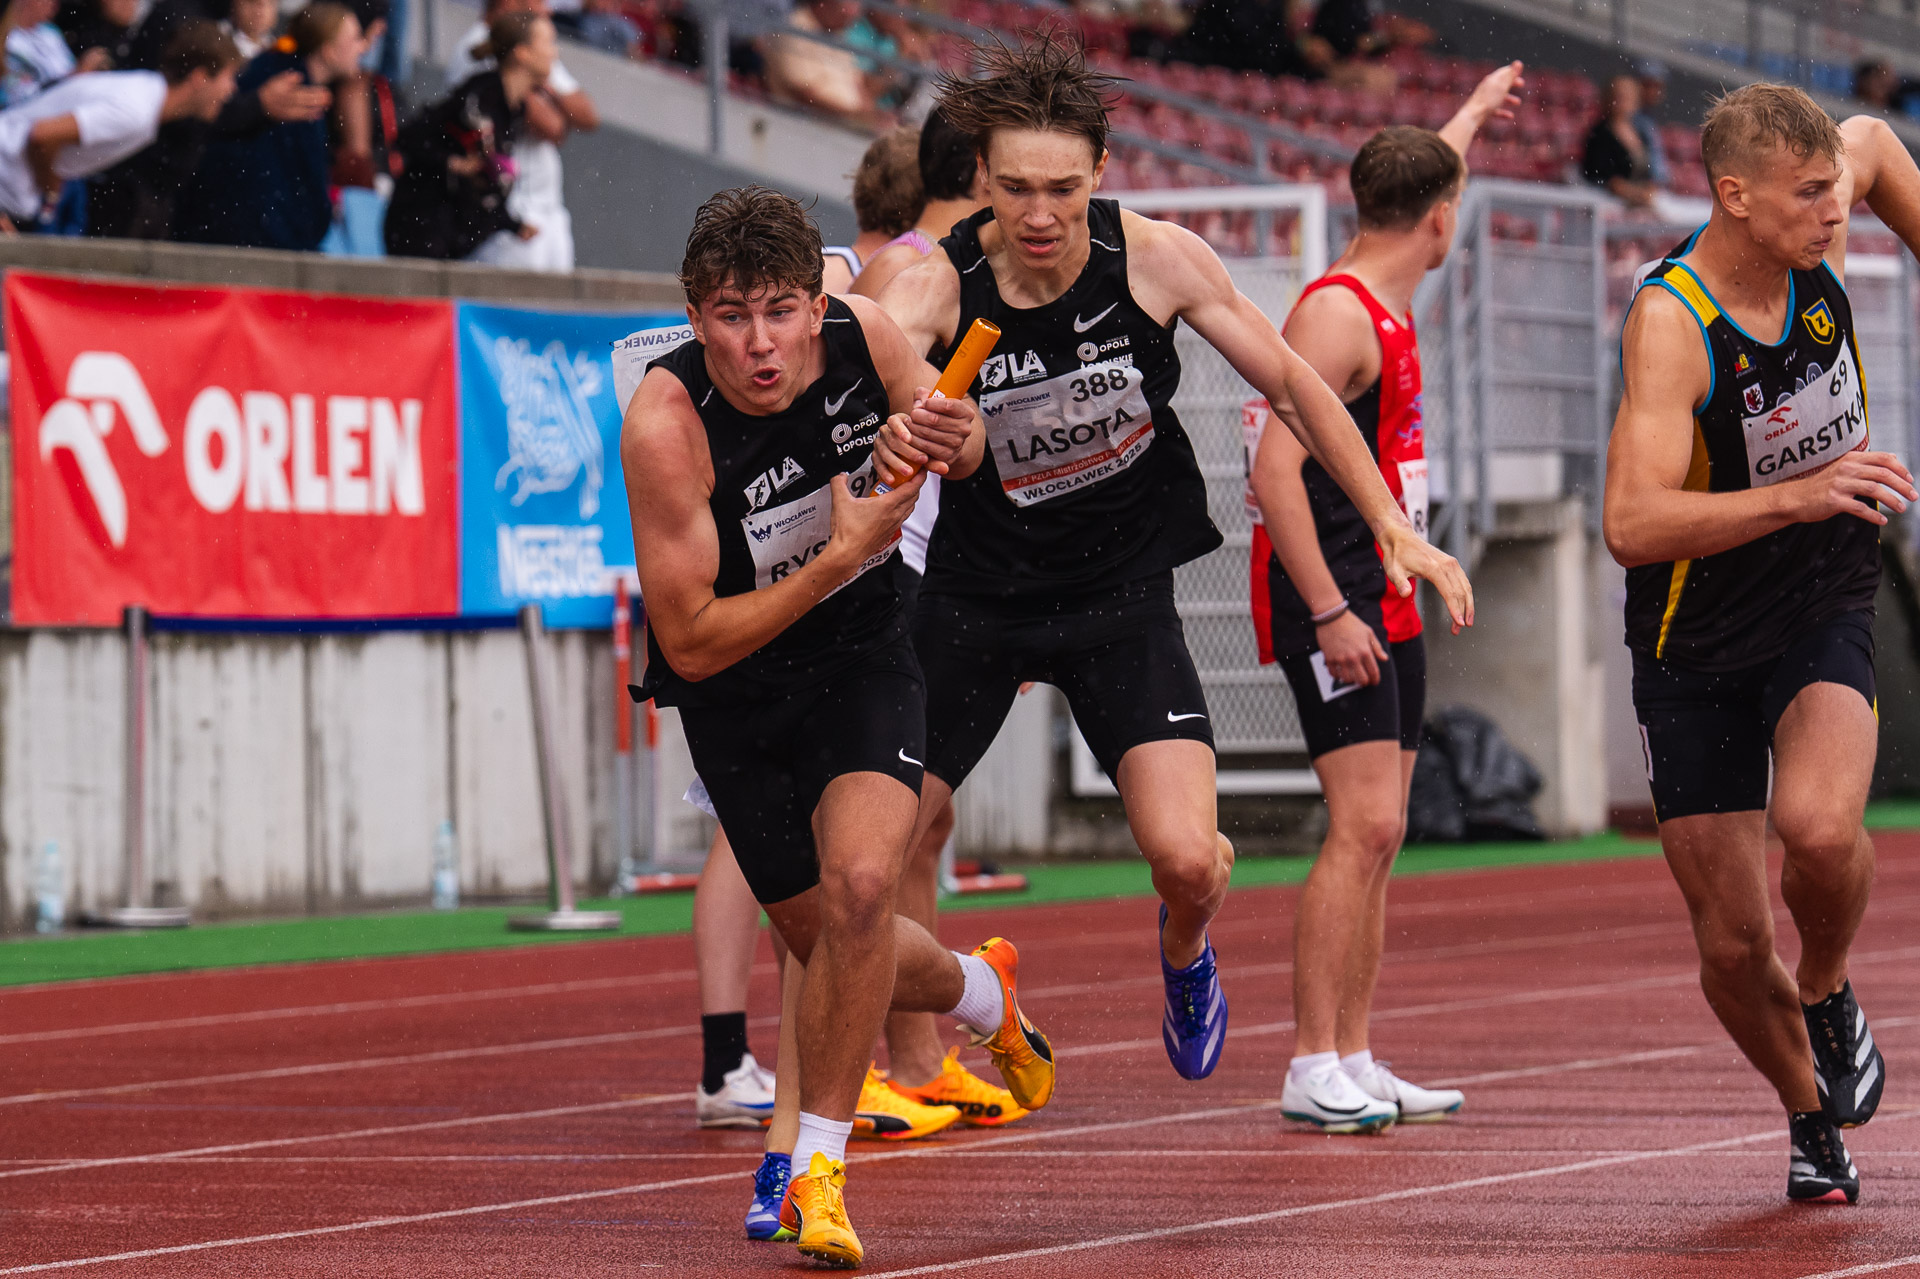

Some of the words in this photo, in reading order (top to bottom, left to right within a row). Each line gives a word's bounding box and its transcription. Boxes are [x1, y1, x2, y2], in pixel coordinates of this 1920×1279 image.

[1099, 338, 1130, 352] OPOLE
[1070, 369, 1128, 402] 388
[1829, 359, 1848, 397] 69
[1006, 392, 1051, 407] WŁOCŁAWEK
[852, 414, 879, 432] OPOLE
[1007, 406, 1135, 464] LASOTA
[1755, 389, 1863, 476] GARSTKA
[1764, 419, 1799, 441] ORLEN
[184, 386, 426, 515] ORLEN
[843, 430, 880, 452] OPOLSK
[1016, 476, 1031, 487] 79.
[1032, 470, 1052, 482] PZLA
[1126, 431, 1141, 445] U20
[1024, 462, 1114, 500] WŁOCŁAWEK
[1115, 443, 1142, 467] 2025
[774, 505, 816, 529] WŁOCŁAWEK
[860, 549, 890, 571] 2025
